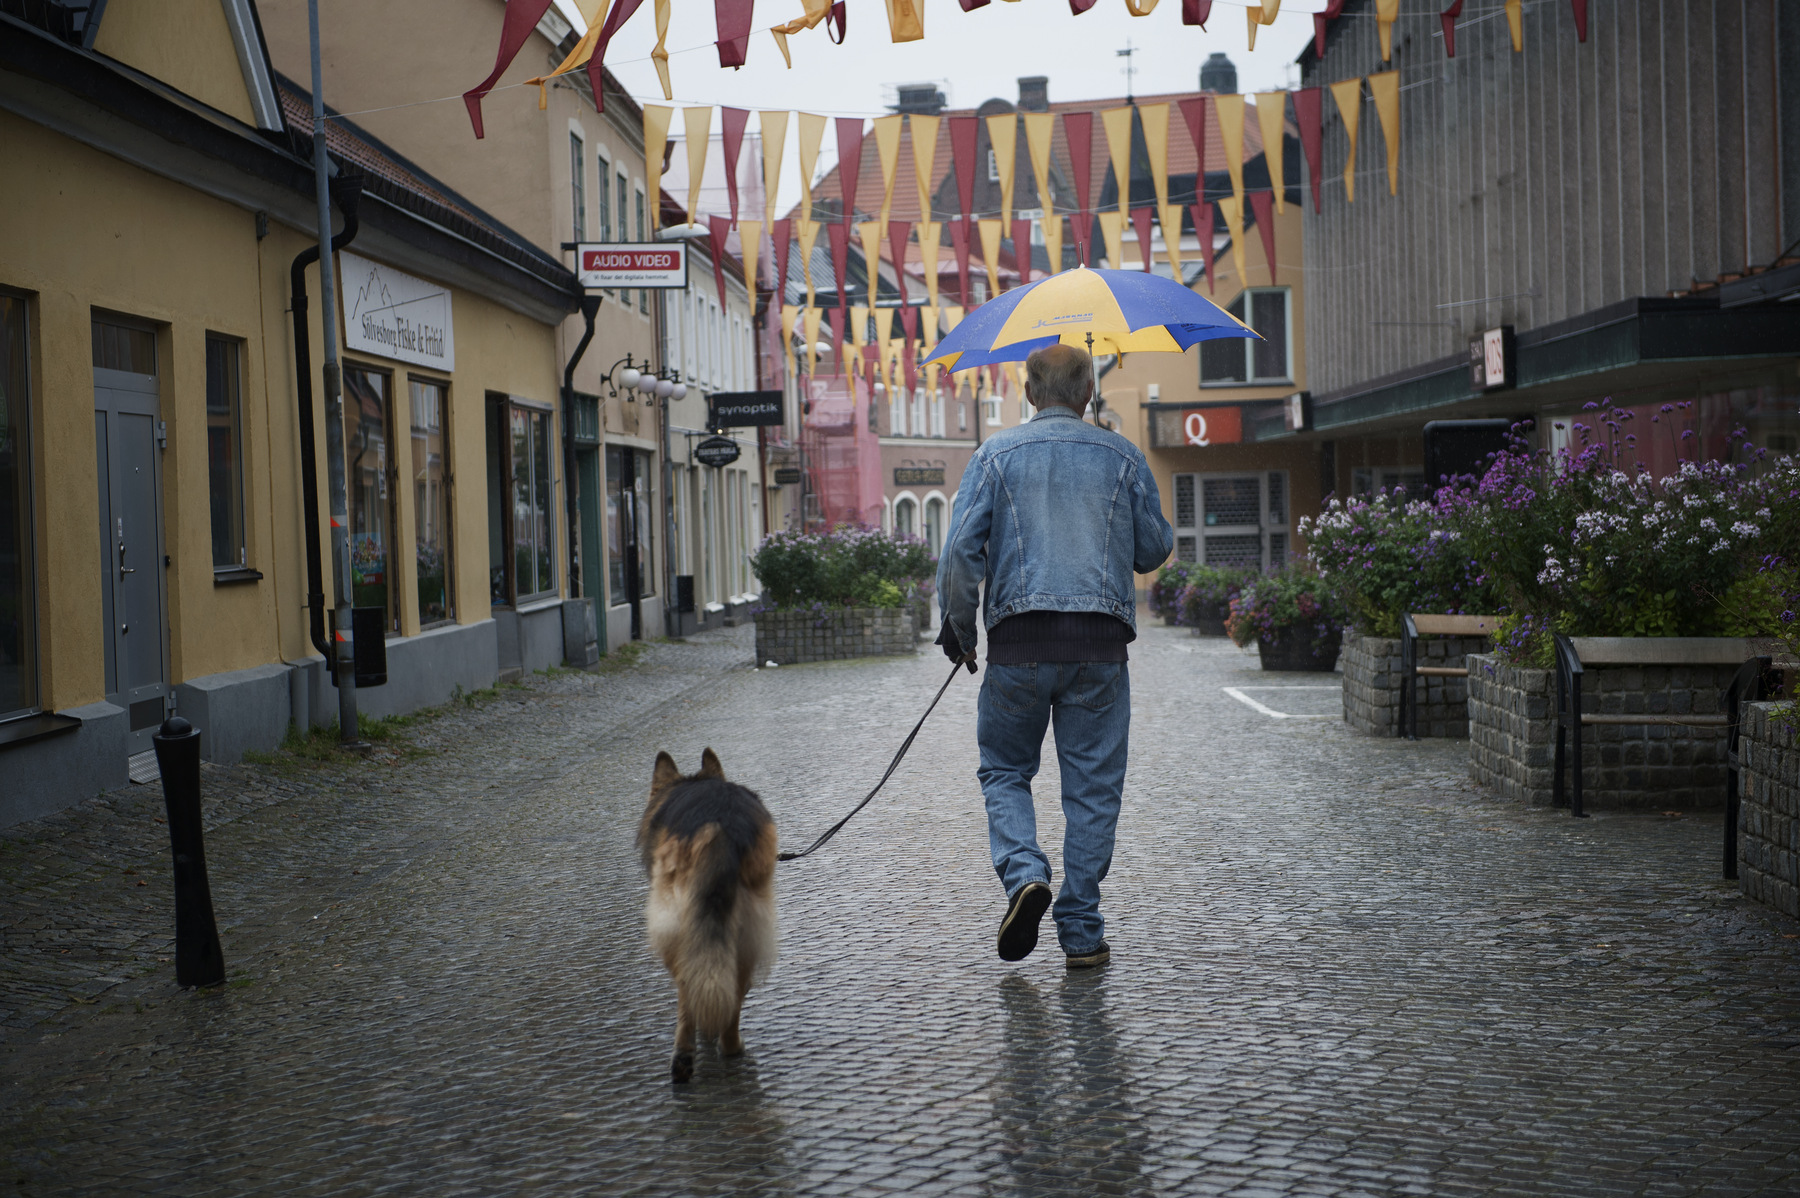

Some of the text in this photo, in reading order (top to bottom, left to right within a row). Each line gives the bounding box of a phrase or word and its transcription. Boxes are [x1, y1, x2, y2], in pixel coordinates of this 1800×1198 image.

[592, 254, 672, 268] AUDIO VIDEO
[361, 313, 445, 359] Sölvesborg Fiske & Fritid
[718, 403, 779, 416] synoptik
[1184, 413, 1210, 447] Q
